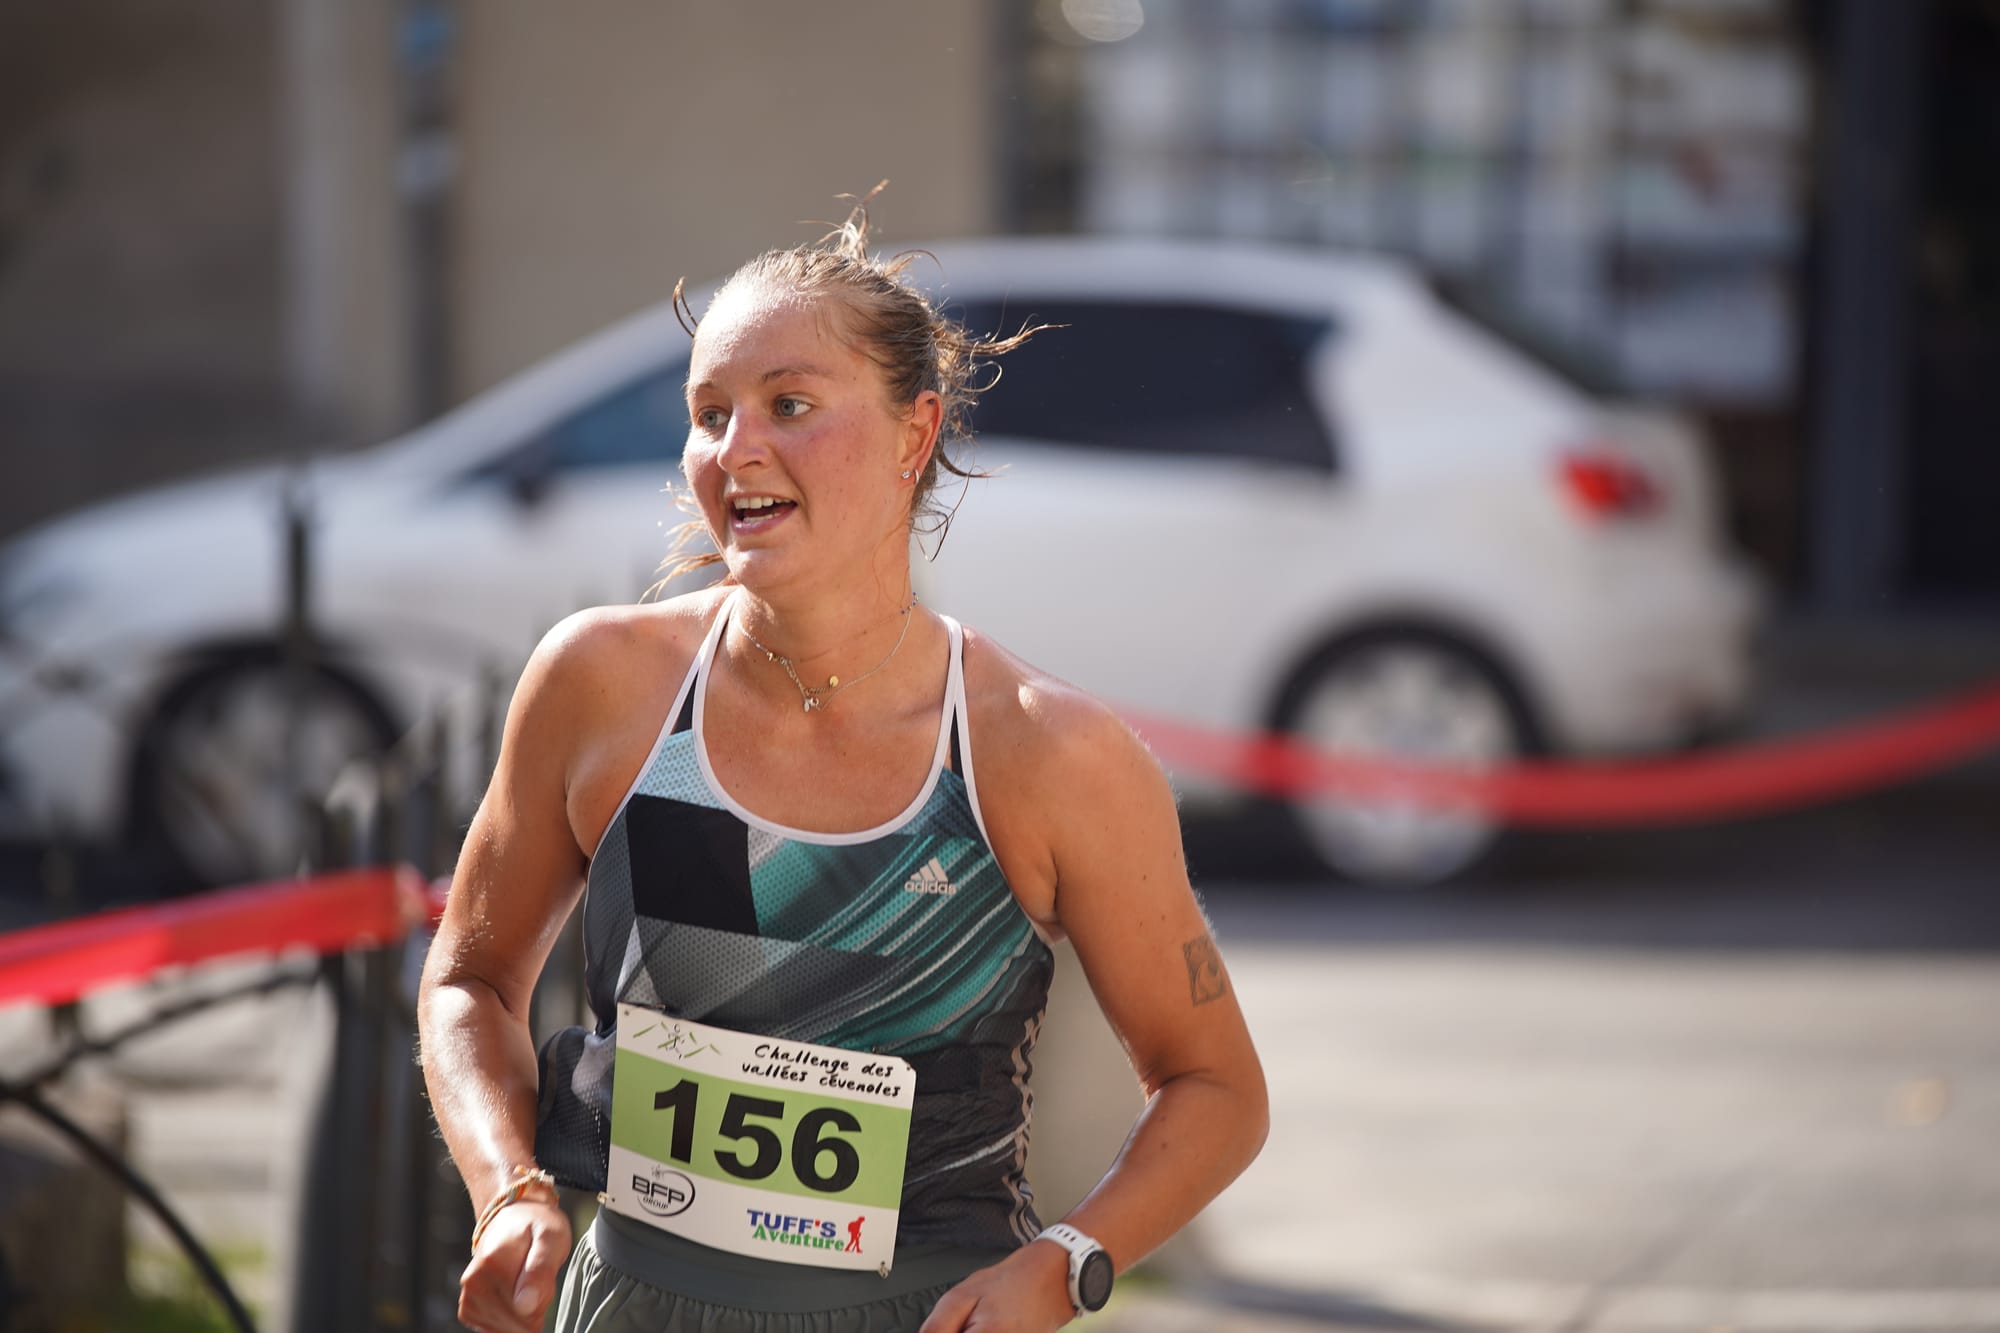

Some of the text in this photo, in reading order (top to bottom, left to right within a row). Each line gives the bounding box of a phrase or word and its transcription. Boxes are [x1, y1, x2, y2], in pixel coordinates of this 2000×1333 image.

[904, 880, 956, 896] adidas
[754, 1044, 894, 1078] Challenge des
[741, 1063, 902, 1097] vallées cévenoles
[653, 1078, 862, 1193] 156
[632, 1174, 685, 1203] BFP
[642, 1196, 669, 1210] GROUP
[746, 1209, 837, 1238] TUFF'S
[752, 1224, 845, 1252] Aventure
